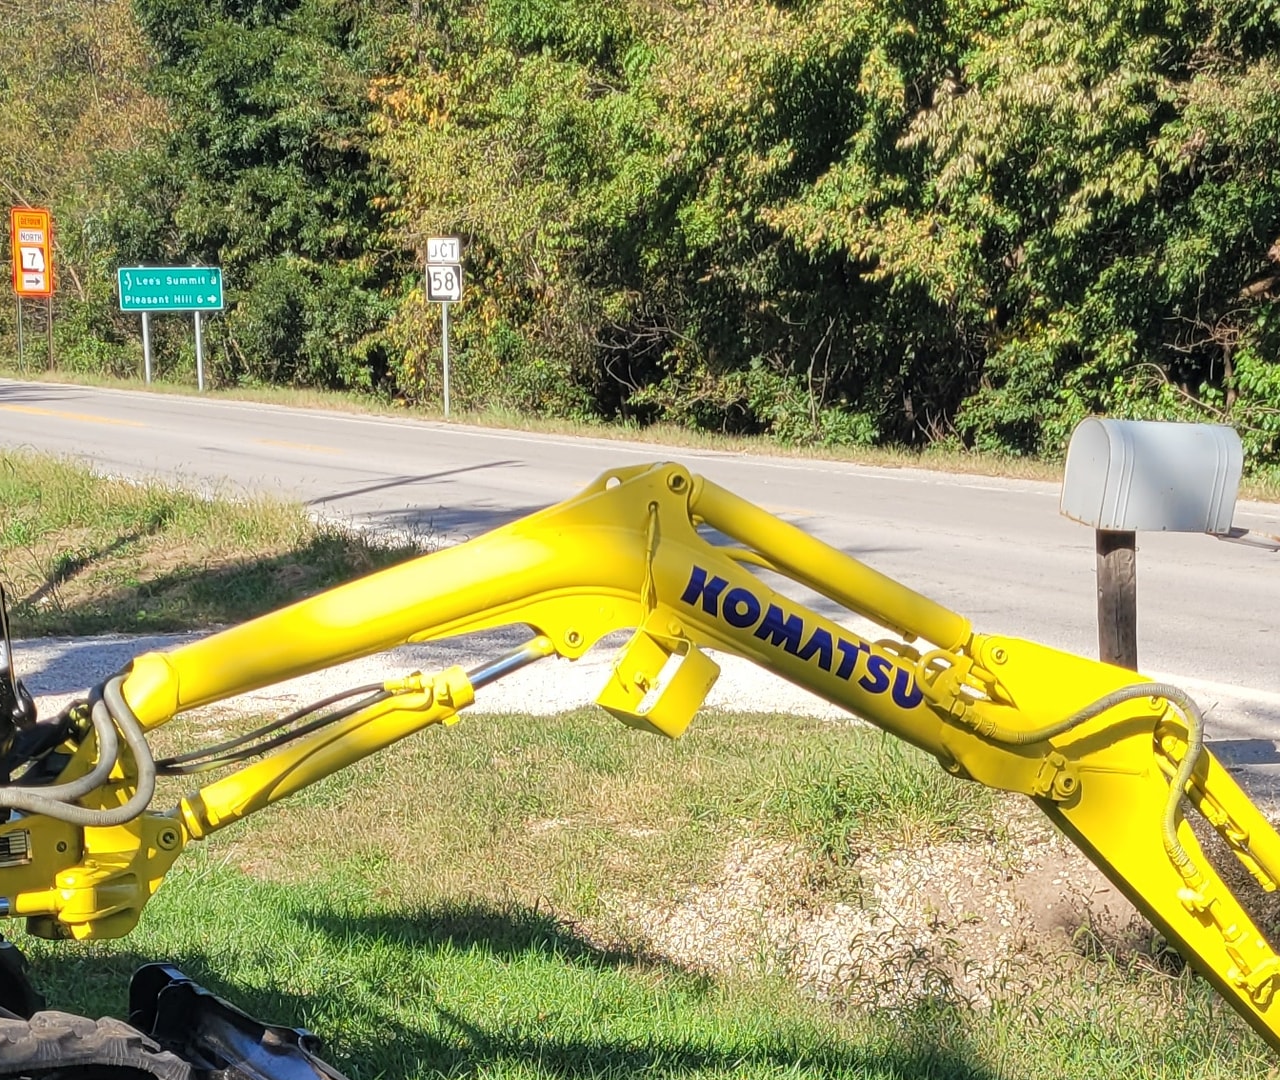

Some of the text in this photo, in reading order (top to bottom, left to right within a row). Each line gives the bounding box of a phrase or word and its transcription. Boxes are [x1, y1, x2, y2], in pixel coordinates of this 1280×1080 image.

[20, 232, 42, 241] NORTH
[430, 242, 456, 258] JCT
[28, 252, 37, 267] 7
[135, 276, 161, 286] Lee's
[166, 276, 206, 286] Summit
[433, 271, 454, 291] 58
[124, 294, 204, 304] Pleasant Hill 6
[680, 564, 925, 709] KOMATSU
